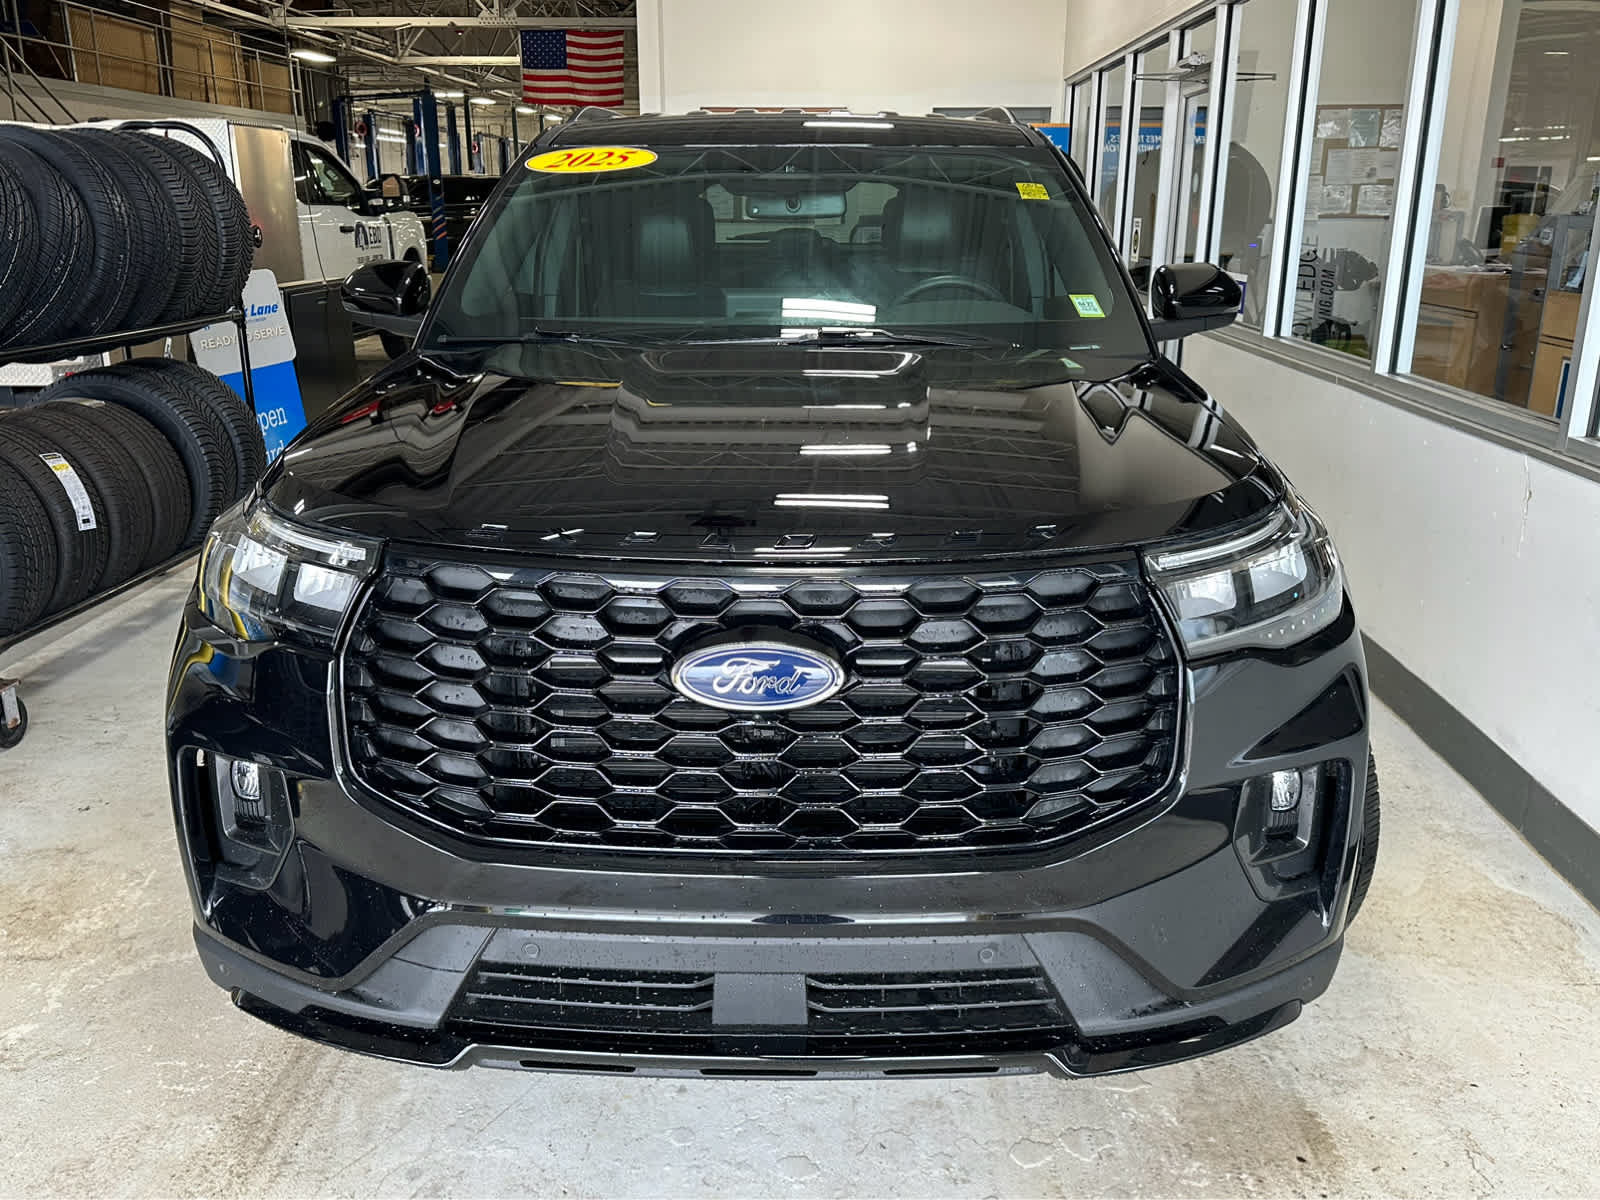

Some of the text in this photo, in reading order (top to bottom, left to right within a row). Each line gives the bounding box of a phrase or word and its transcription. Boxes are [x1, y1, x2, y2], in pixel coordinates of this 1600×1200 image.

[544, 150, 639, 169] 2025
[1291, 234, 1319, 338] OWLEDGE
[1318, 268, 1336, 321] ING.COM
[250, 303, 279, 317] Lane
[255, 326, 287, 340] SERVE
[257, 407, 288, 436] pen
[712, 656, 812, 695] Ford
